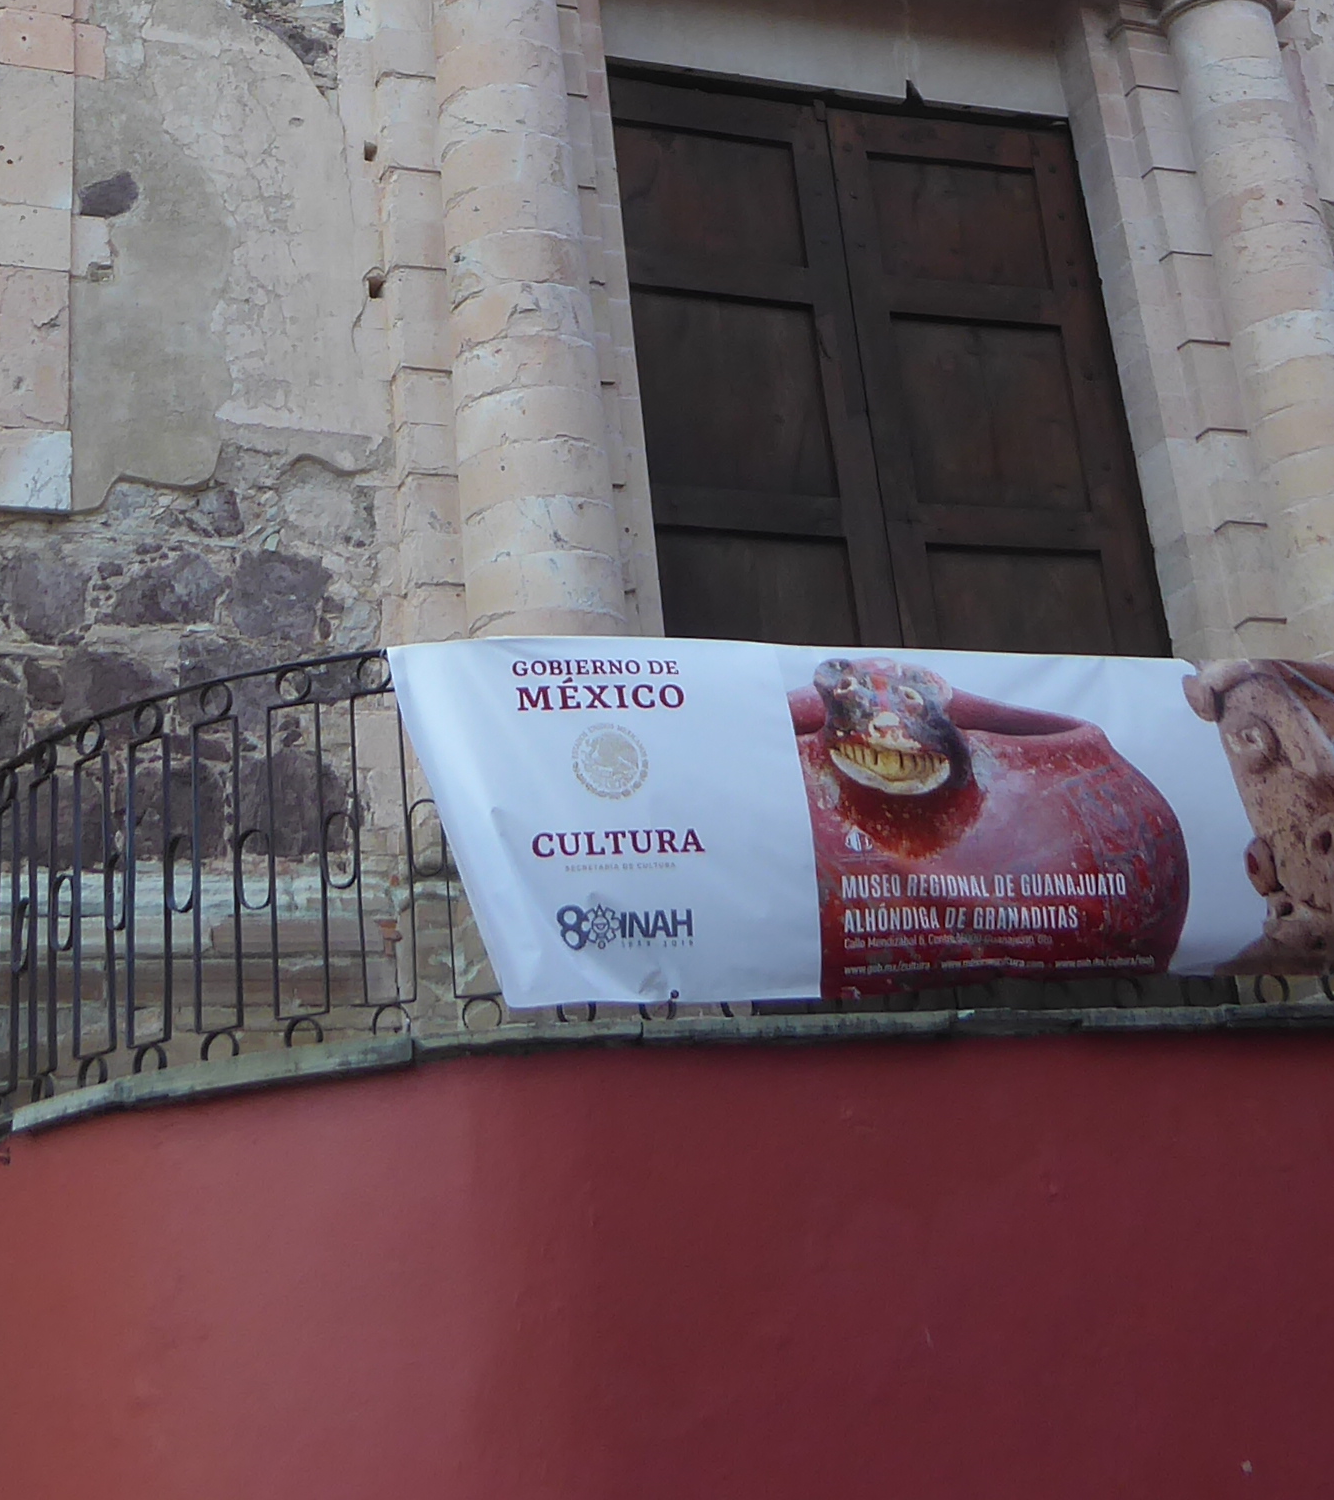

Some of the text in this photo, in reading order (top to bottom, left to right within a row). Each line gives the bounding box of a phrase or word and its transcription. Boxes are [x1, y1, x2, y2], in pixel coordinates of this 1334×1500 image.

[512, 659, 679, 677] GOBIERNO DE
[516, 677, 685, 711] MÉXICO
[532, 828, 705, 858] CULTURA
[841, 873, 1127, 899] MUSEO REGIONAL DE GUANAJUATO
[620, 909, 693, 939] INAH
[844, 902, 1079, 933] ALHÓNDIGA DE GRANADITAS
